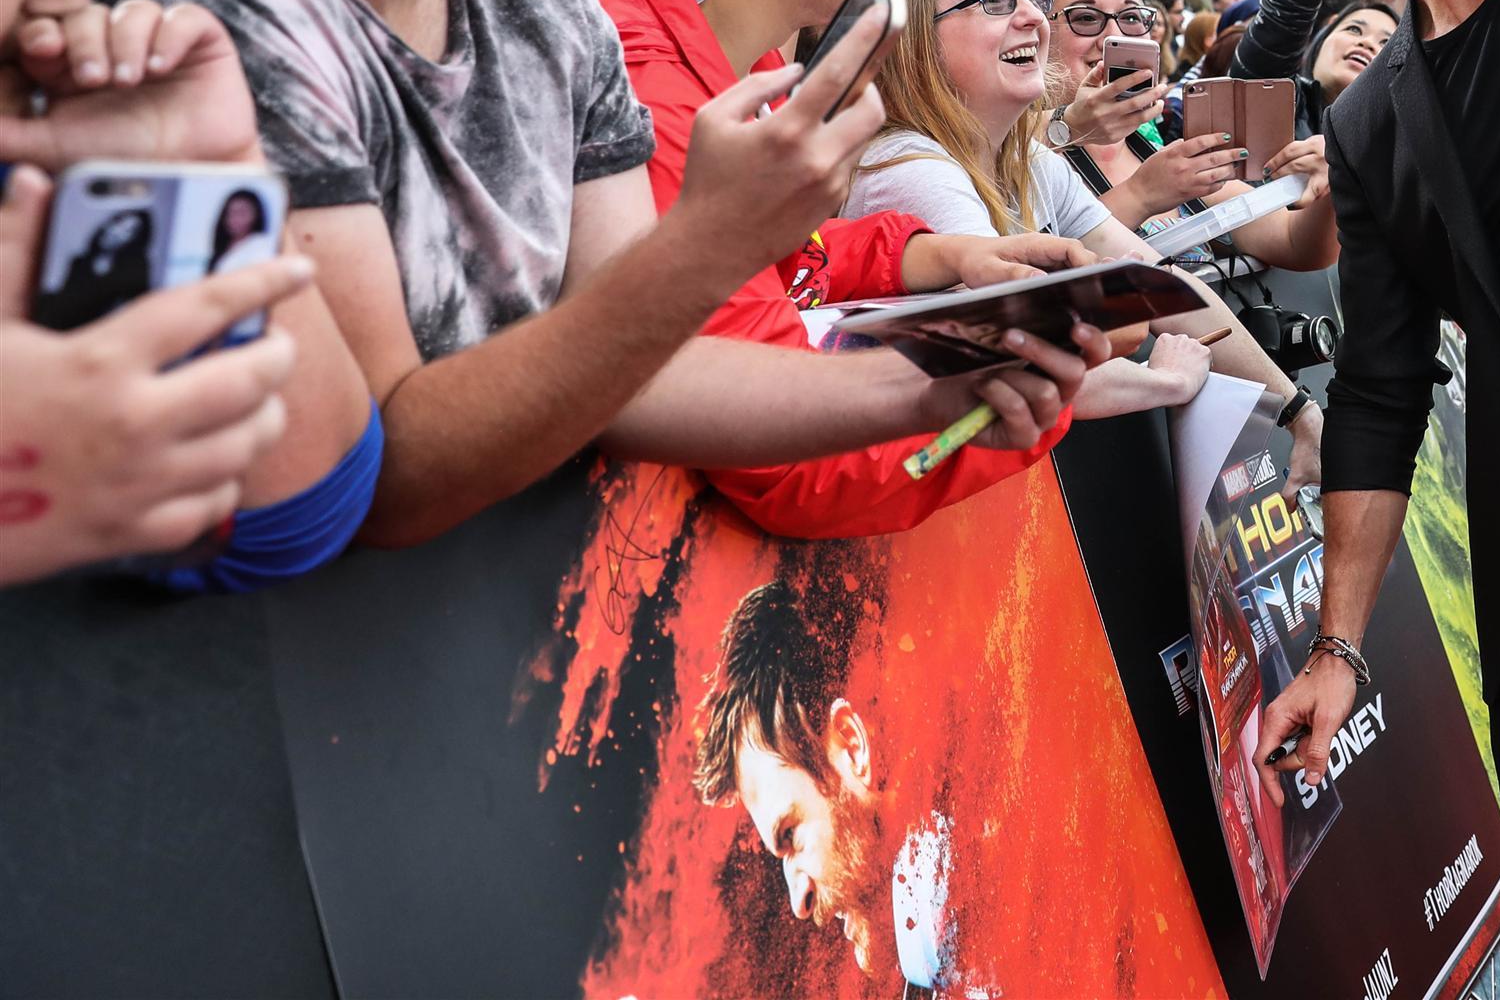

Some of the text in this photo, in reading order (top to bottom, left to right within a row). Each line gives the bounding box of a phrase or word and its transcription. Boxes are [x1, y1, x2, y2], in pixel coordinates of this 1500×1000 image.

[1222, 452, 1277, 499] MARVEL STUDIOS
[1223, 645, 1238, 669] THOR
[1295, 692, 1387, 810] SDNEY
